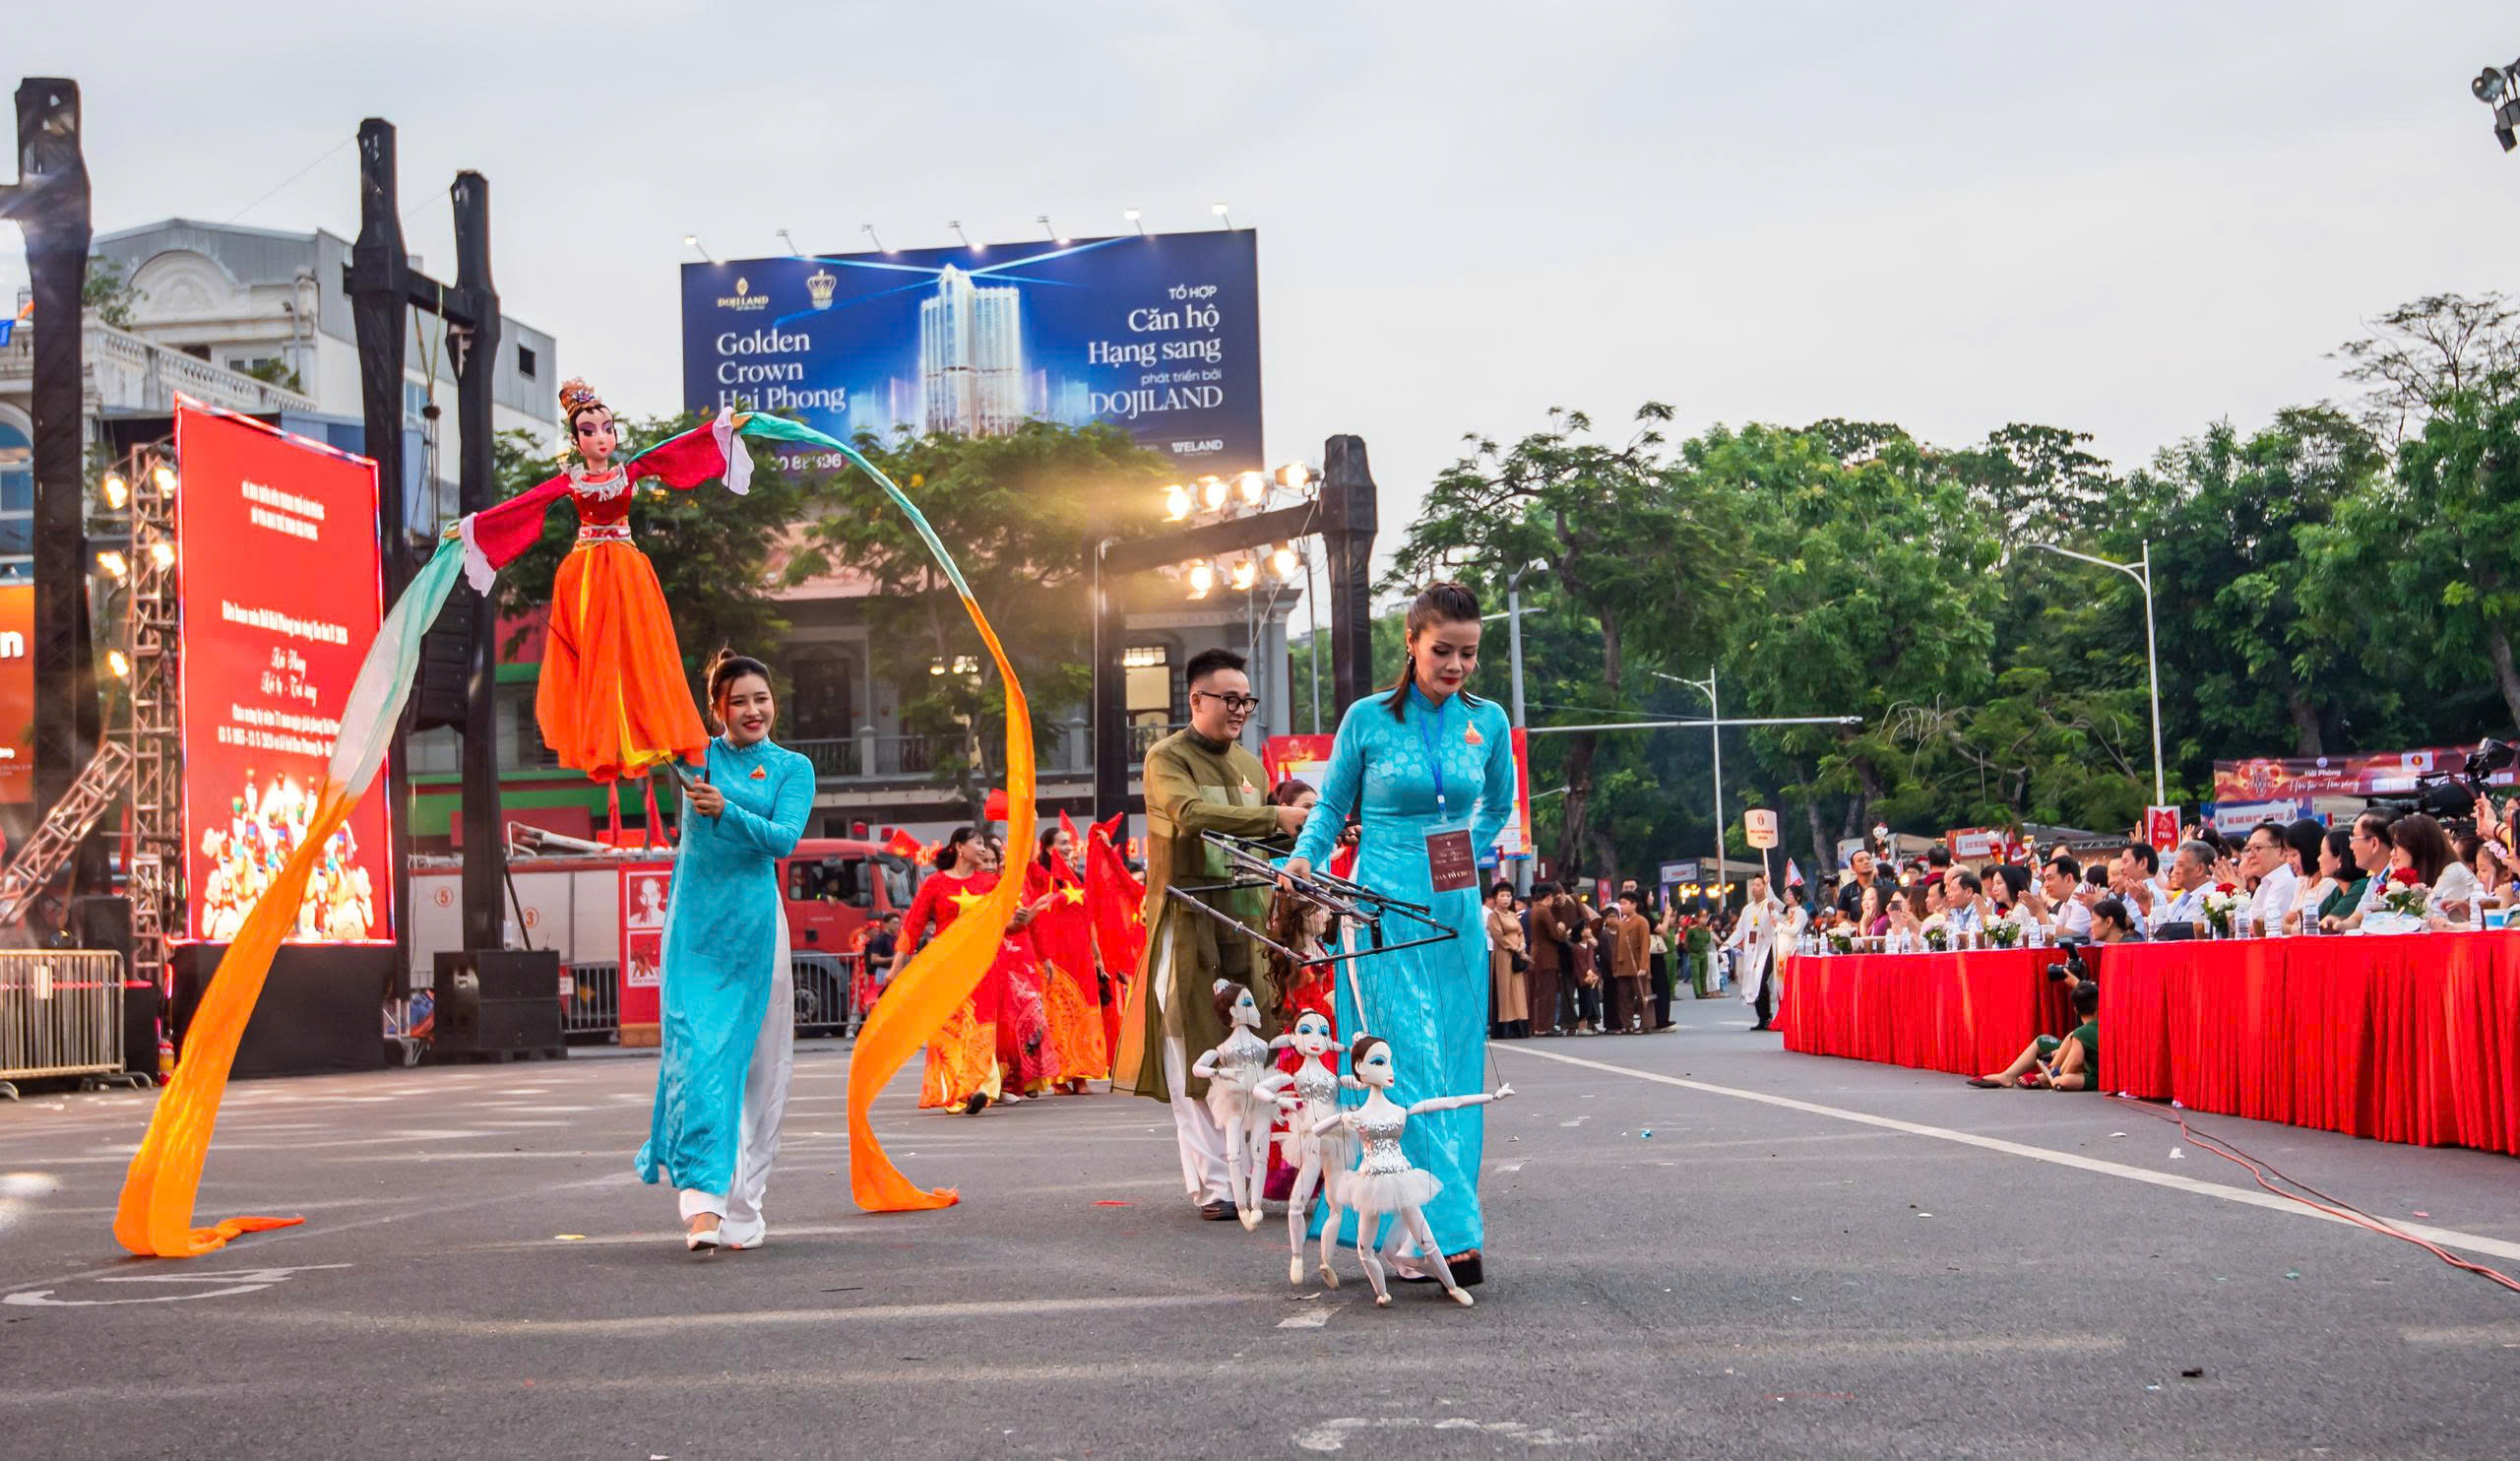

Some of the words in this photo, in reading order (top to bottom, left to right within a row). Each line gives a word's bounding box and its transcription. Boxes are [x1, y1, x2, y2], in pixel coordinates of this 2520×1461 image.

[1128, 307, 1179, 332] Căn
[1186, 303, 1220, 333] hộ
[717, 329, 811, 355] Golden
[1088, 341, 1158, 368] Hạng
[1162, 338, 1223, 363] sang
[718, 361, 803, 384] Crown
[1141, 371, 1170, 386] phát
[1172, 368, 1200, 383] triển
[1202, 369, 1223, 381] bởi
[720, 387, 760, 411] Hai
[766, 385, 846, 413] Phong
[1089, 386, 1224, 419] DOJILAND
[1171, 439, 1224, 453] WELAND
[440, 890, 449, 904] 5
[527, 912, 534, 925] 3
